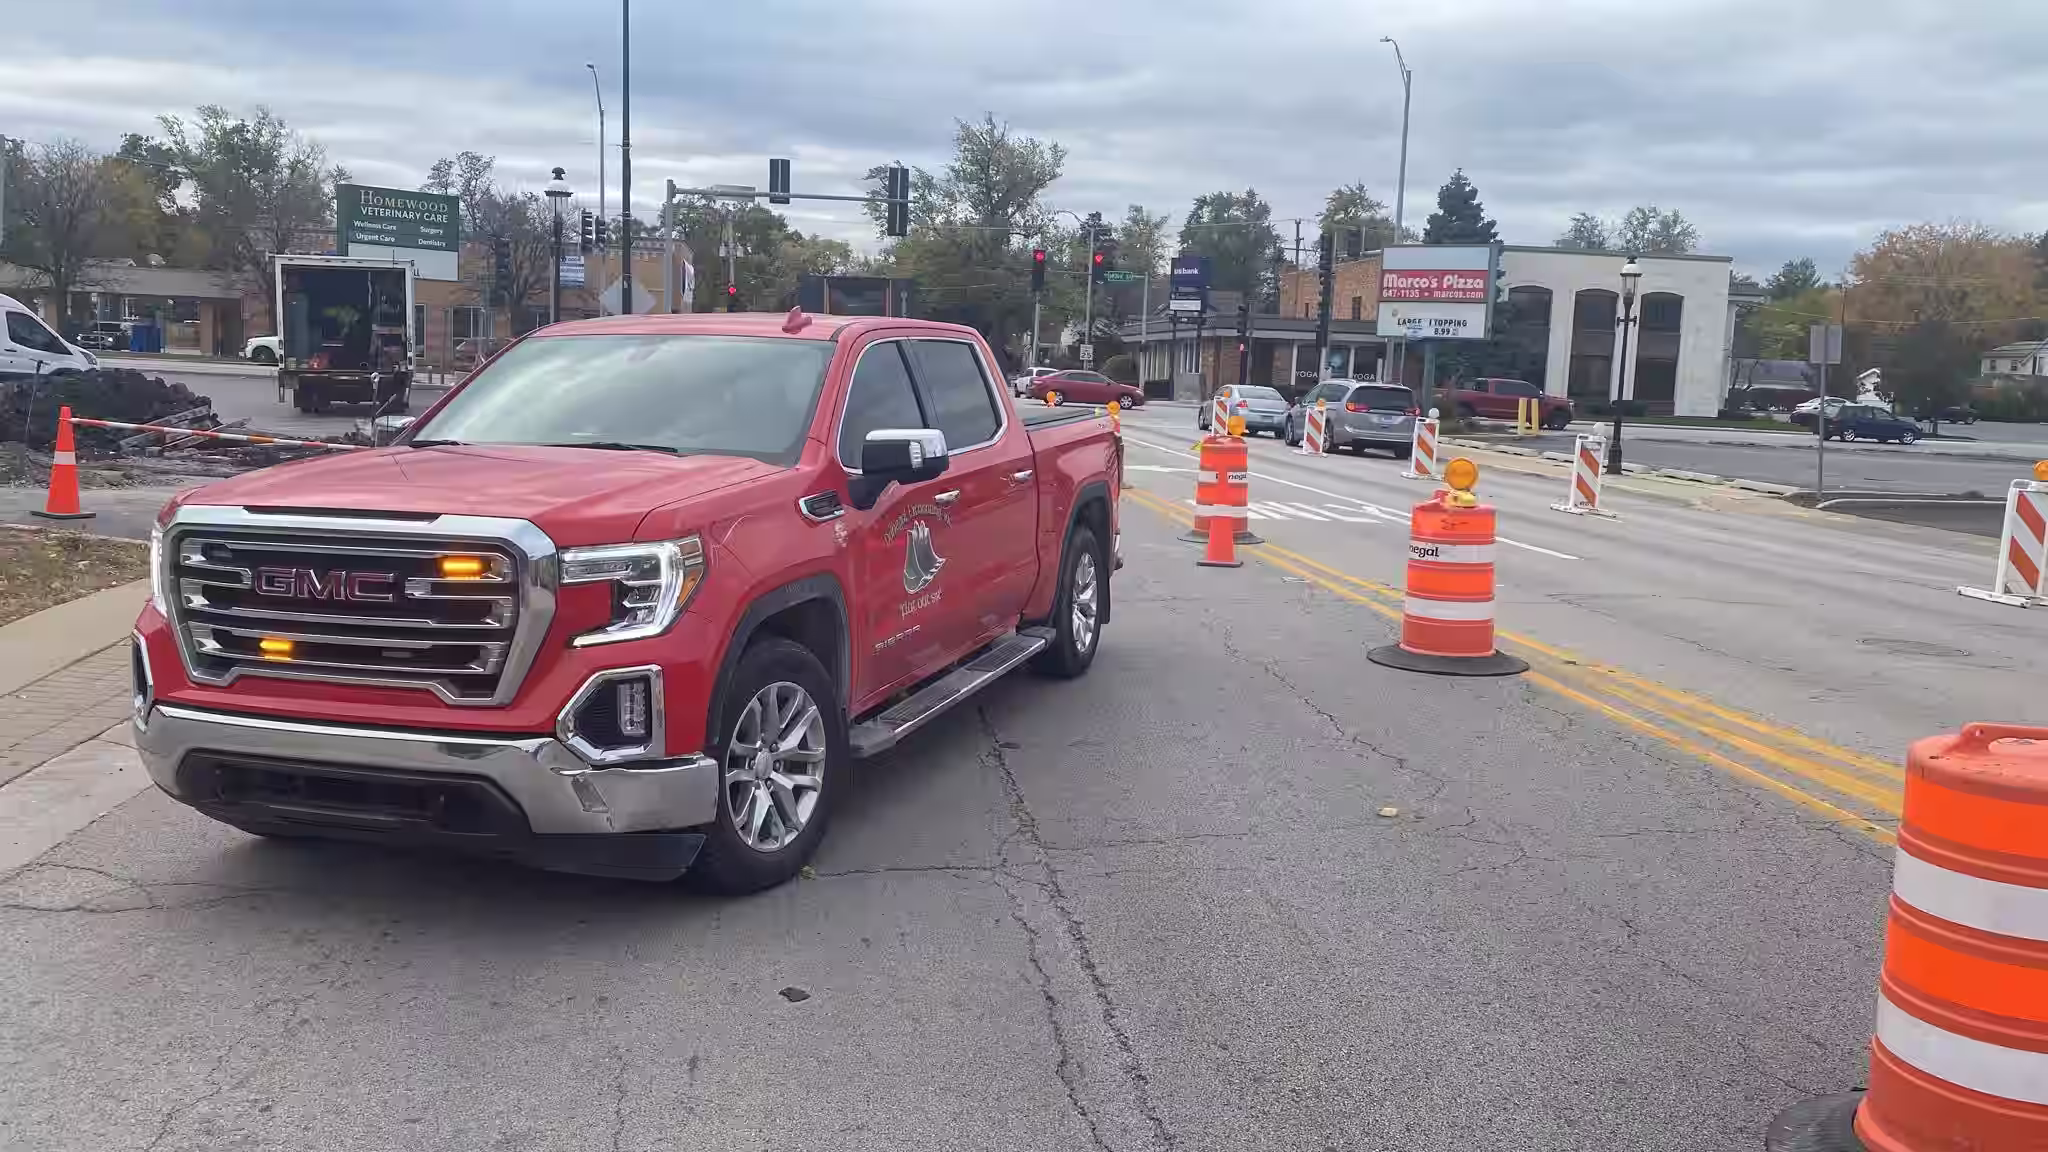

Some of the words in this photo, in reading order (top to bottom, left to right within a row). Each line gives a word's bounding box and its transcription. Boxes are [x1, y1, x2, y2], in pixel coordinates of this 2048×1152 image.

[360, 190, 448, 212] HOMEWOOD
[360, 206, 421, 220] VETERINARY
[424, 212, 448, 223] CARE
[353, 220, 381, 229] Wellness
[382, 223, 397, 231] Care
[420, 226, 443, 235] Surgery
[356, 233, 379, 242] Urgent
[418, 239, 446, 248] Dentistry
[1383, 273, 1438, 289] Marco's
[1443, 274, 1484, 289] Pizza
[1383, 289, 1420, 298] 647-1135
[1433, 289, 1484, 299] marcos.com
[1295, 370, 1318, 378] YOGA
[255, 567, 396, 602] GMC
